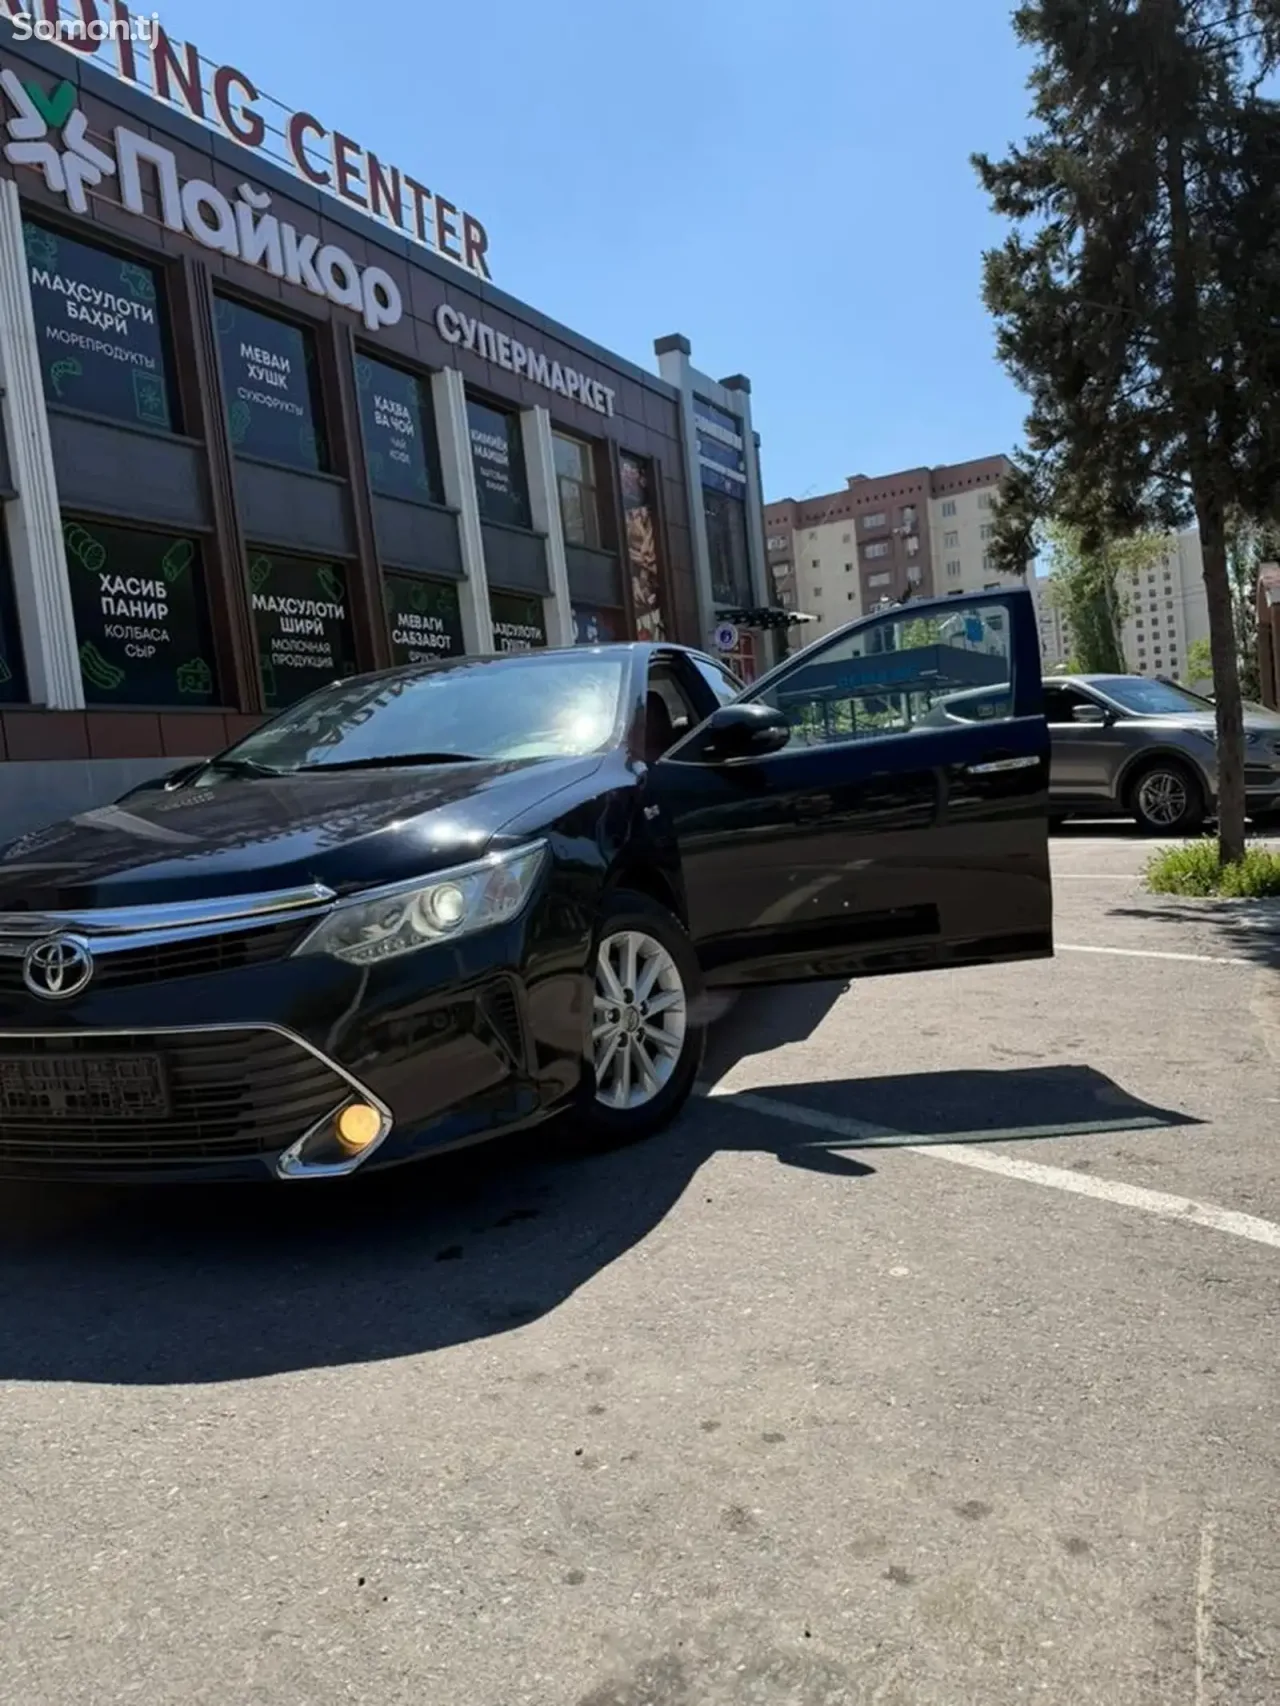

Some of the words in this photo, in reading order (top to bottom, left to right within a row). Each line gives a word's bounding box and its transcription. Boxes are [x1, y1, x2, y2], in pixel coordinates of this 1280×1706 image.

[284, 112, 494, 283] CENTER
[114, 126, 402, 332] Пайкар
[46, 327, 155, 369] МОРЕПРОДУКТЫ
[436, 303, 615, 418] СУПЕРМАРКЕТ
[247, 363, 288, 391] ХУШК
[101, 597, 168, 620] ПАНИР
[105, 624, 170, 642] КОЛБАСА
[392, 629, 452, 650] САБЗАВОТ
[125, 644, 156, 658] СЫР
[271, 638, 331, 653] МОЛОЧНАЯ
[272, 653, 334, 668] ПРОДУКЦИЯ
